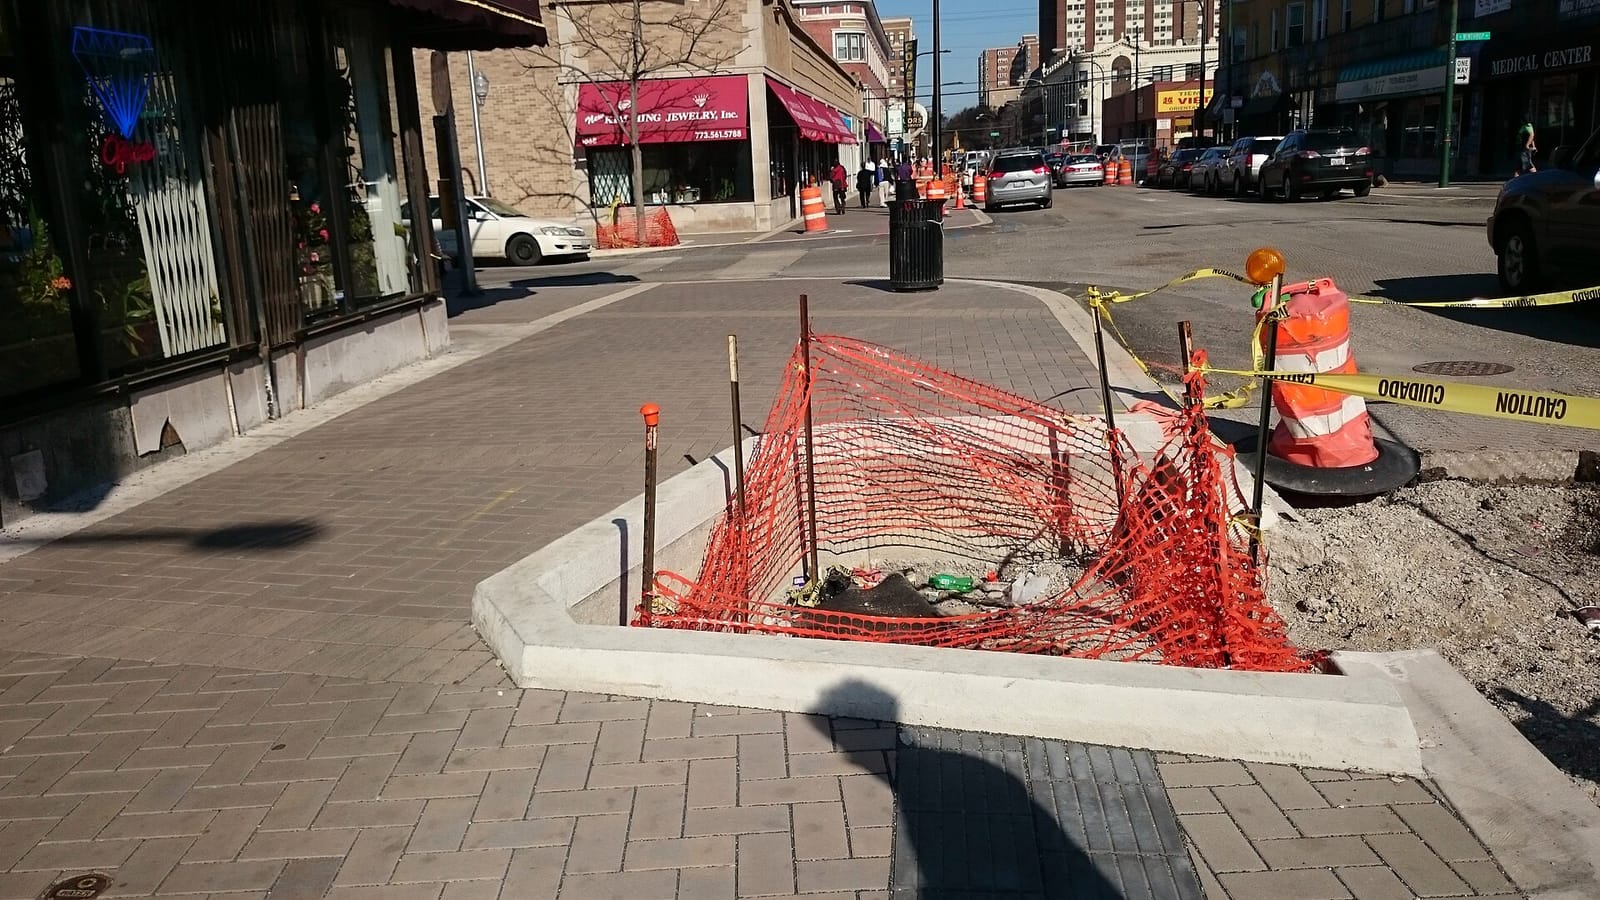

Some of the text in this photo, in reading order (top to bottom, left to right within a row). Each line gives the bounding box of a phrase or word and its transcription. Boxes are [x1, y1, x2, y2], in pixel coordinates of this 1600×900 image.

[1491, 45, 1592, 75] MEDICAL CENTER
[665, 110, 718, 122] JEWELRY,
[721, 110, 738, 119] Inc.
[1378, 379, 1444, 404] CUIDADO
[1495, 391, 1567, 419] CAUTION
